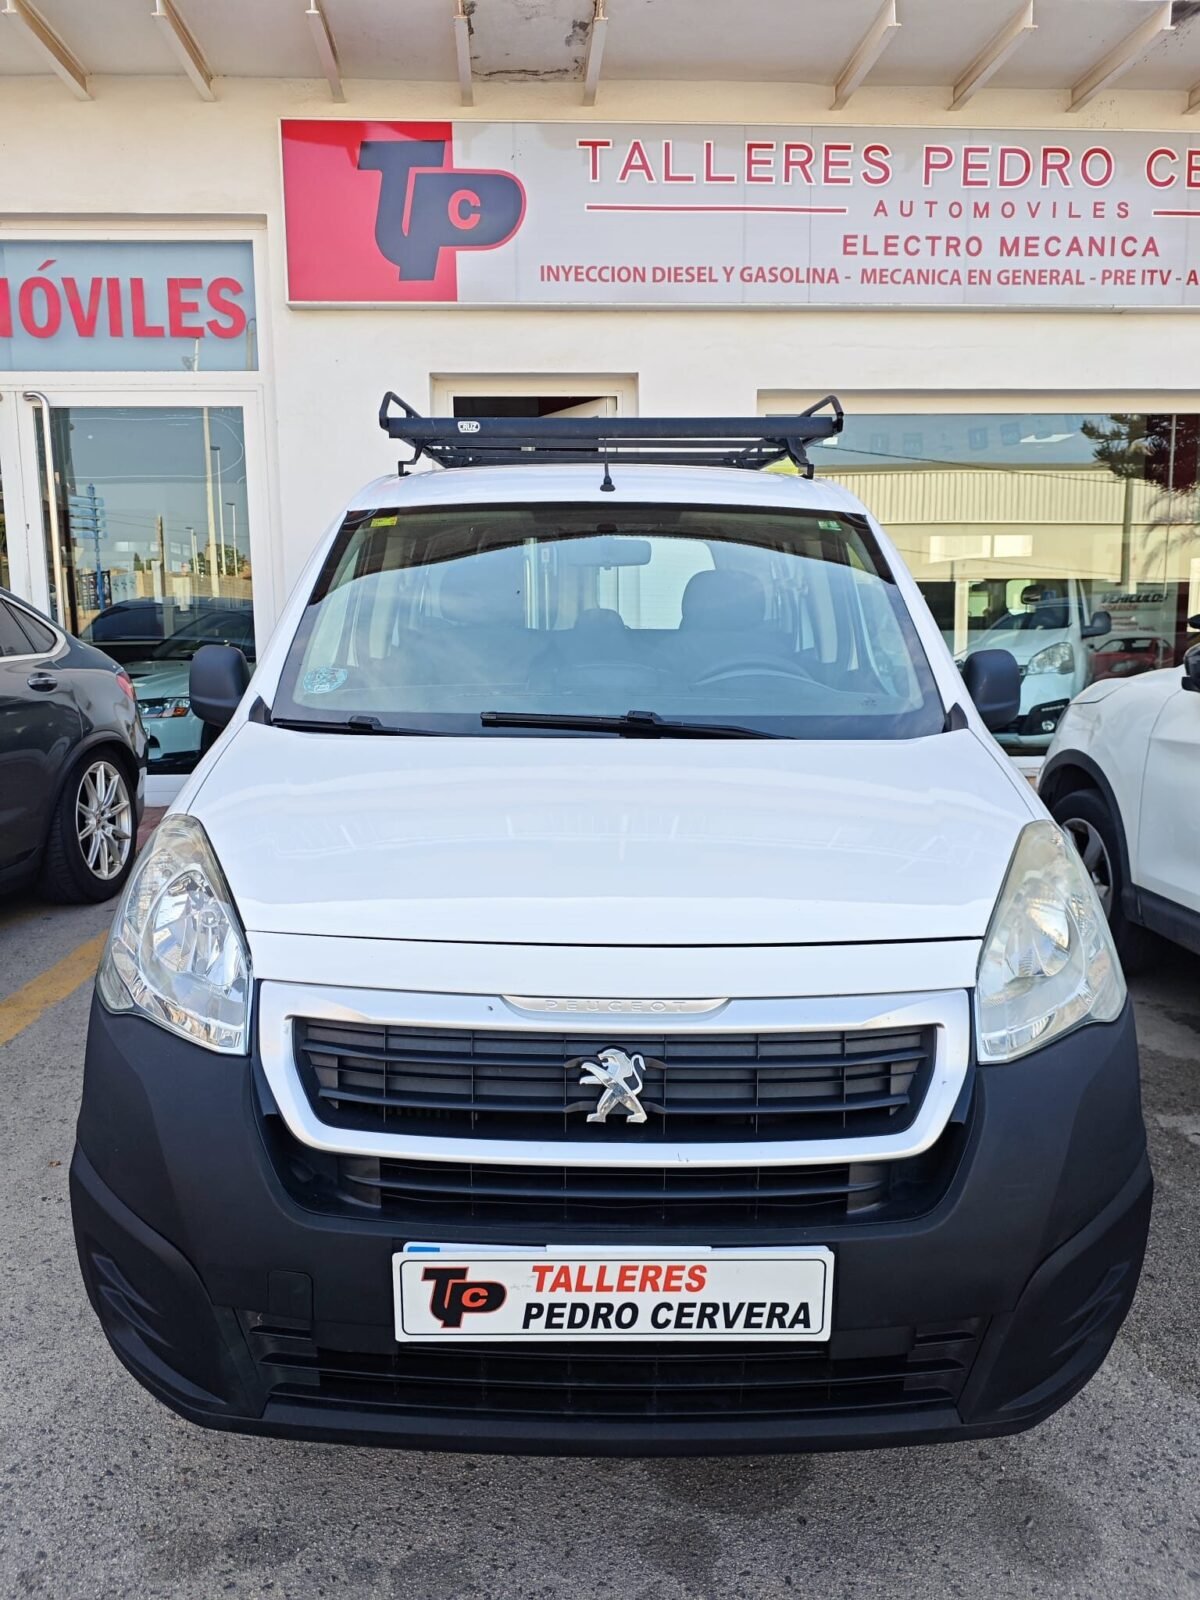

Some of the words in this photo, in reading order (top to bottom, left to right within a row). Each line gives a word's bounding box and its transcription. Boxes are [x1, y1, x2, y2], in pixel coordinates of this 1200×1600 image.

[577, 138, 892, 186] TALLERES
[922, 144, 1116, 189] PEDRO
[873, 200, 1130, 219] AUTOMOVILES
[842, 234, 984, 257] ELECTRO
[1000, 236, 1160, 257] MECANICA
[540, 265, 646, 282] INYECCION
[652, 266, 718, 283] DIESEL
[723, 266, 735, 283] Y
[740, 266, 840, 284] GASOLINA
[861, 268, 962, 285] MECANICA
[967, 269, 992, 285] EN
[997, 269, 1085, 286] GENERAL
[1101, 269, 1136, 285] PRE
[1141, 270, 1172, 286] ITV
[0, 259, 247, 339] ÓVILES
[544, 1000, 686, 1012] PEUGEOT
[531, 1265, 708, 1293] TALLERES
[522, 1302, 639, 1330] PEDRO
[650, 1302, 812, 1330] CERVERA
